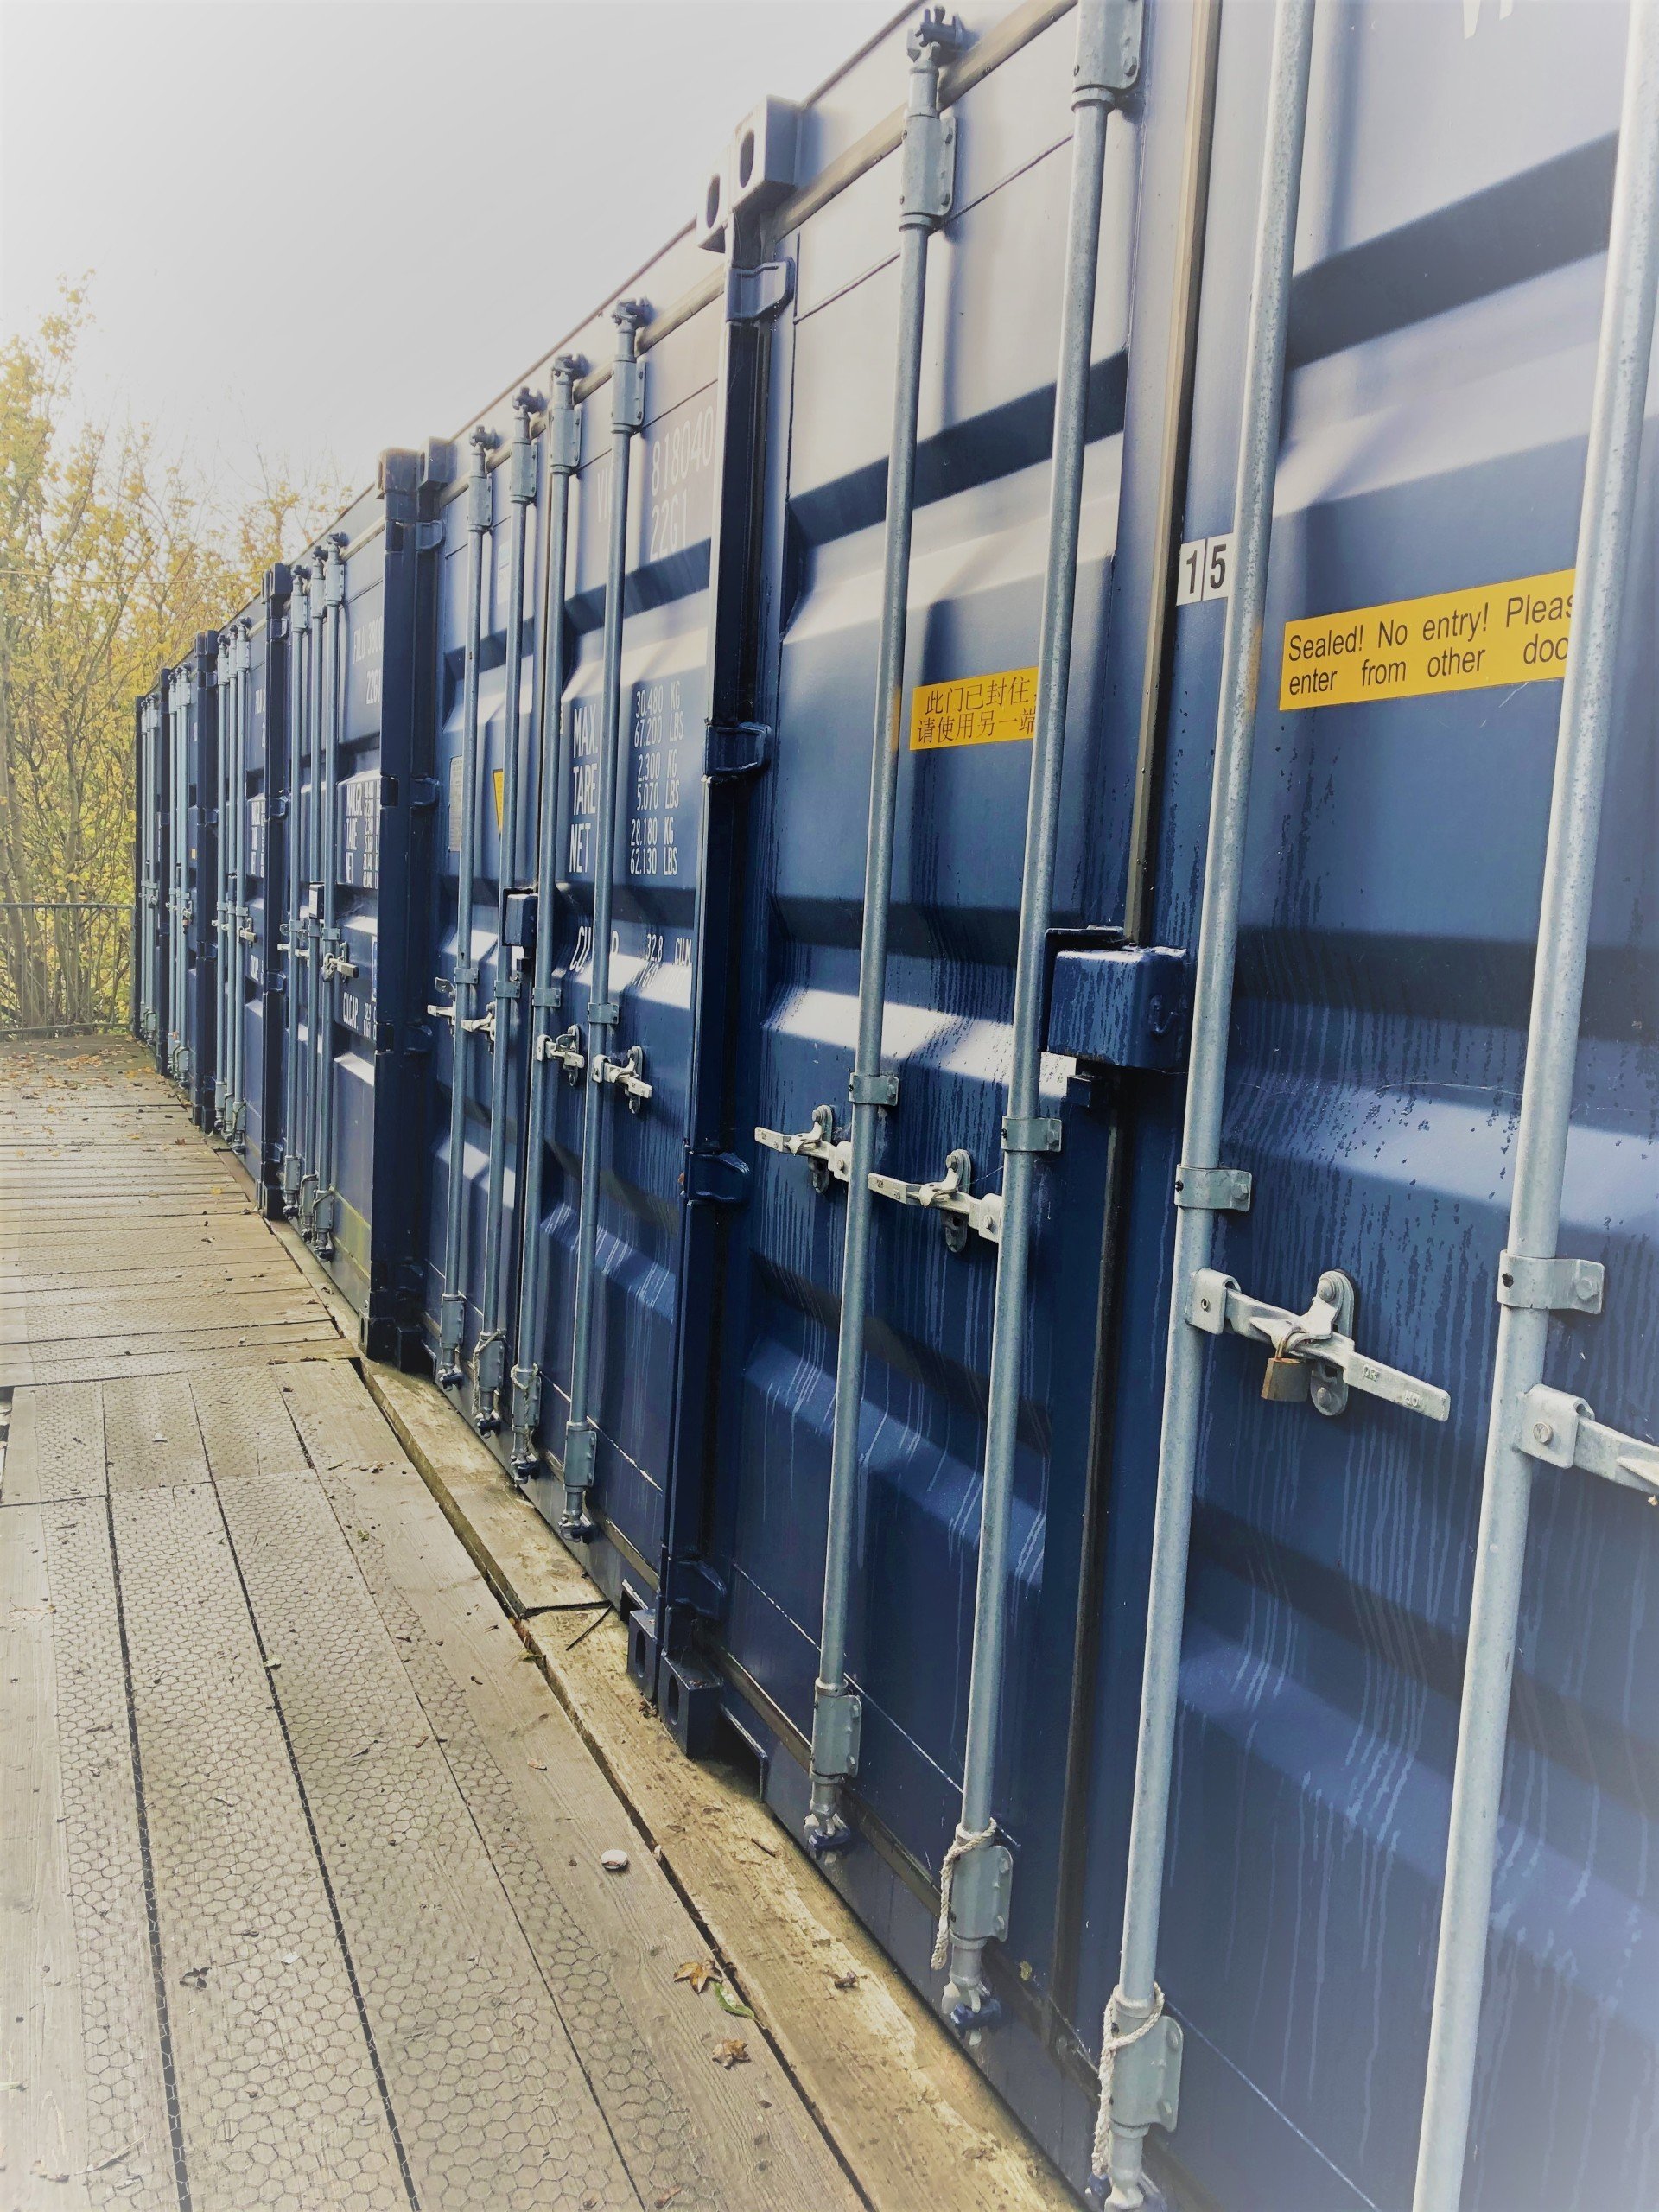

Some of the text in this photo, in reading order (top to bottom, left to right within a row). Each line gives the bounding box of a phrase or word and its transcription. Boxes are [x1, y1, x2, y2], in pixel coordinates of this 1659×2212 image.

[651, 405, 714, 497] 818040
[649, 488, 688, 562] 22G1
[1185, 543, 1227, 594] 15
[1288, 623, 1363, 663] Sealed!
[1377, 620, 1408, 649] No
[1422, 602, 1489, 643] entry!
[670, 680, 681, 710] KG
[1288, 667, 1338, 696] enter
[1361, 658, 1407, 688] from
[1427, 646, 1486, 679] other
[669, 710, 684, 742] LBS
[667, 748, 678, 779] KG
[573, 762, 598, 816] TARE
[664, 779, 680, 810] LBS
[569, 823, 592, 873] NET
[664, 816, 674, 845] KG
[663, 846, 678, 876] LBS
